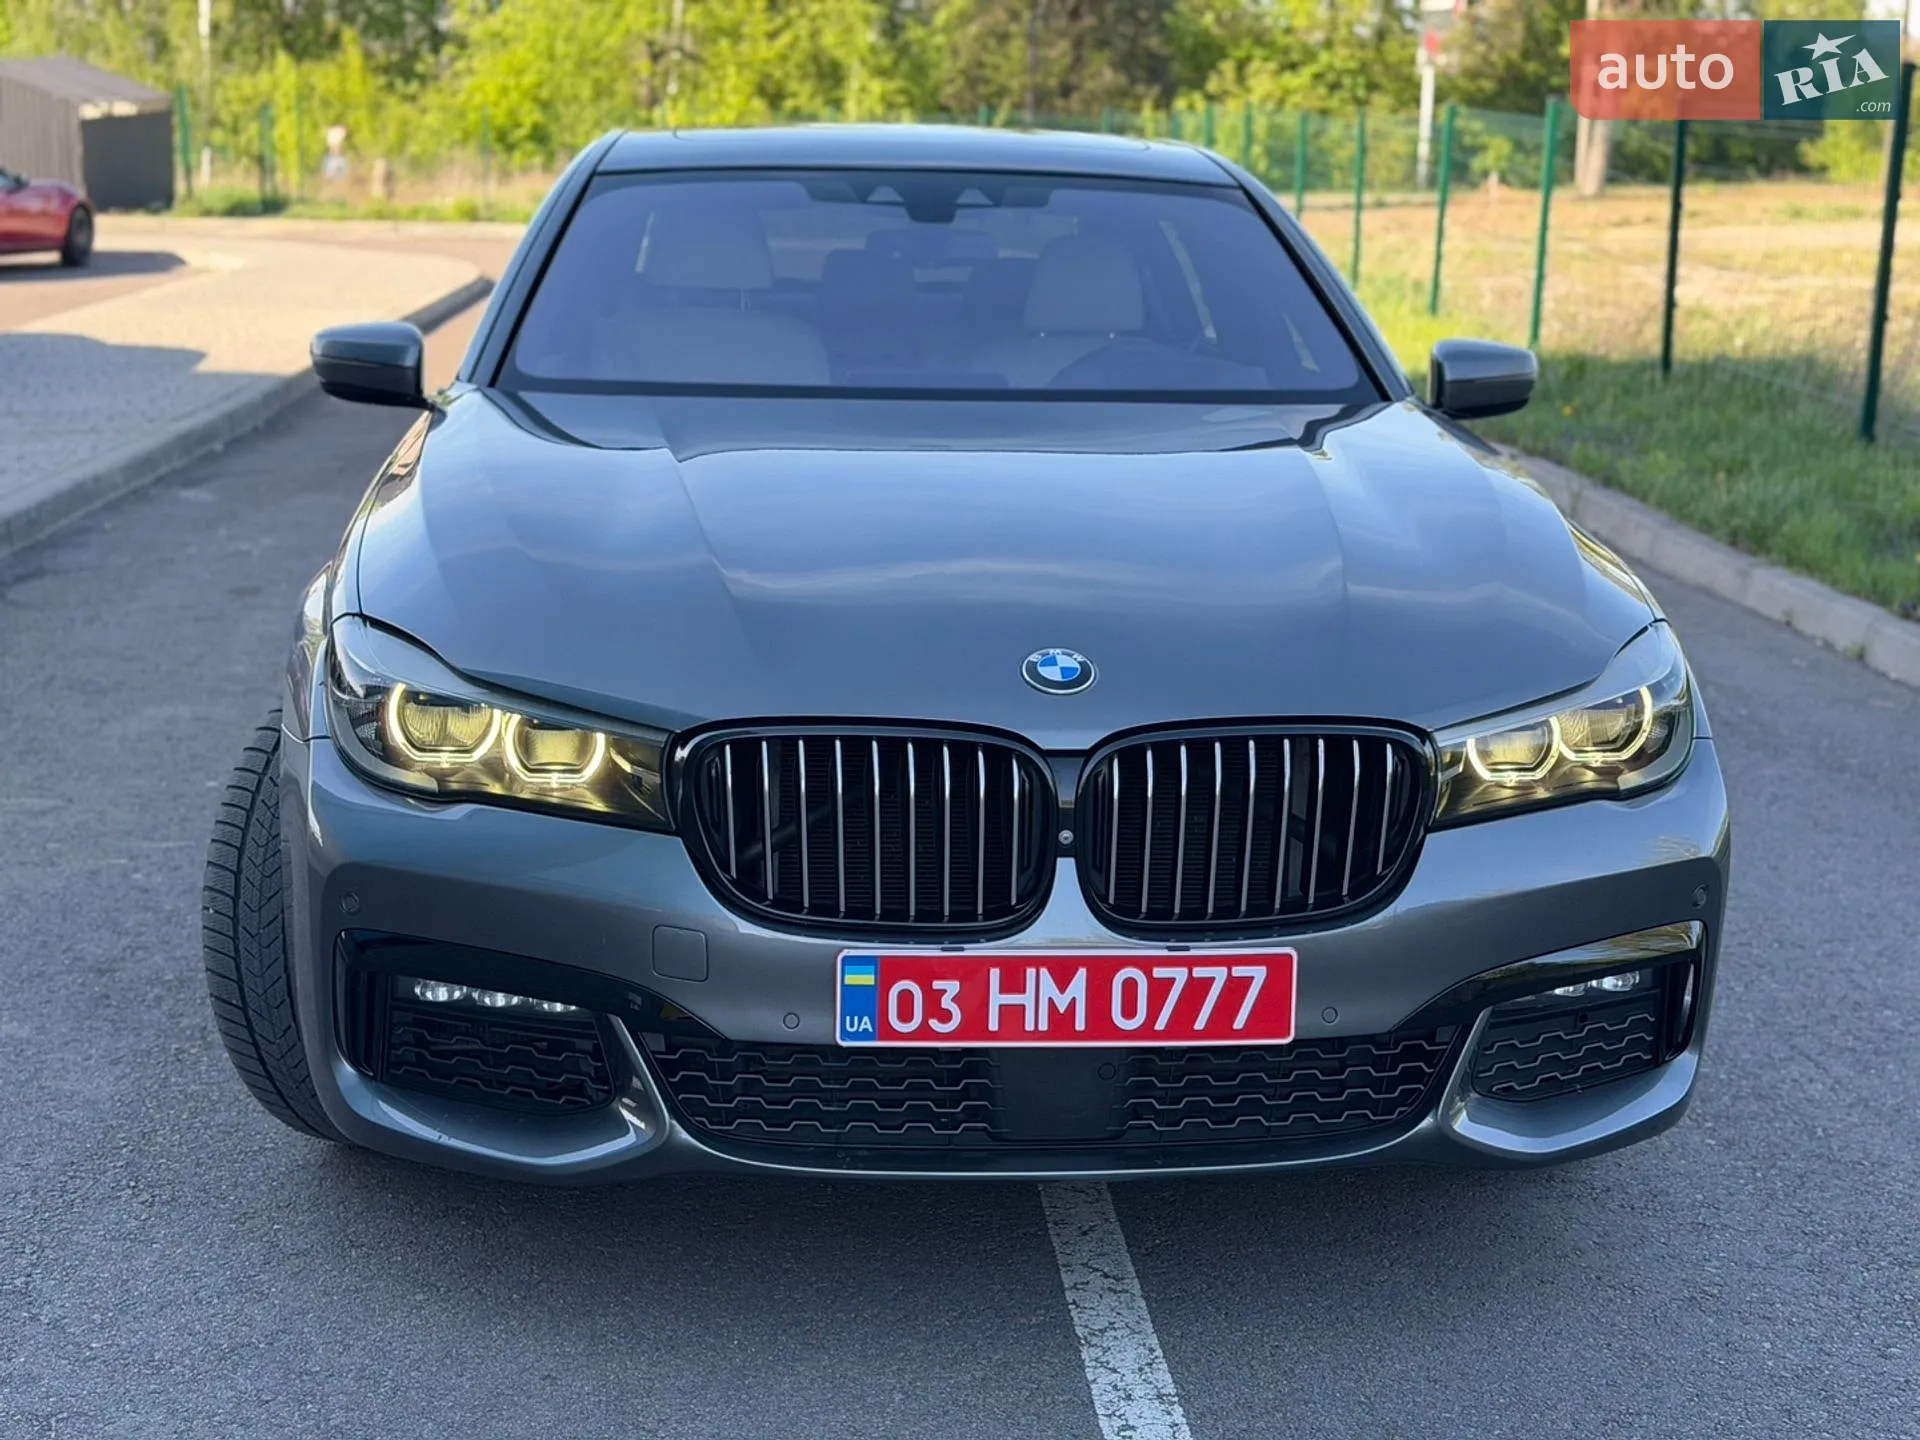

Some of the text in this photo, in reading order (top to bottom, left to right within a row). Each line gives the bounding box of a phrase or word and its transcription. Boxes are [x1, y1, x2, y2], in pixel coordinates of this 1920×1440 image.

[887, 966, 1267, 1033] 03 HM 0777
[846, 1016, 873, 1032] UA
